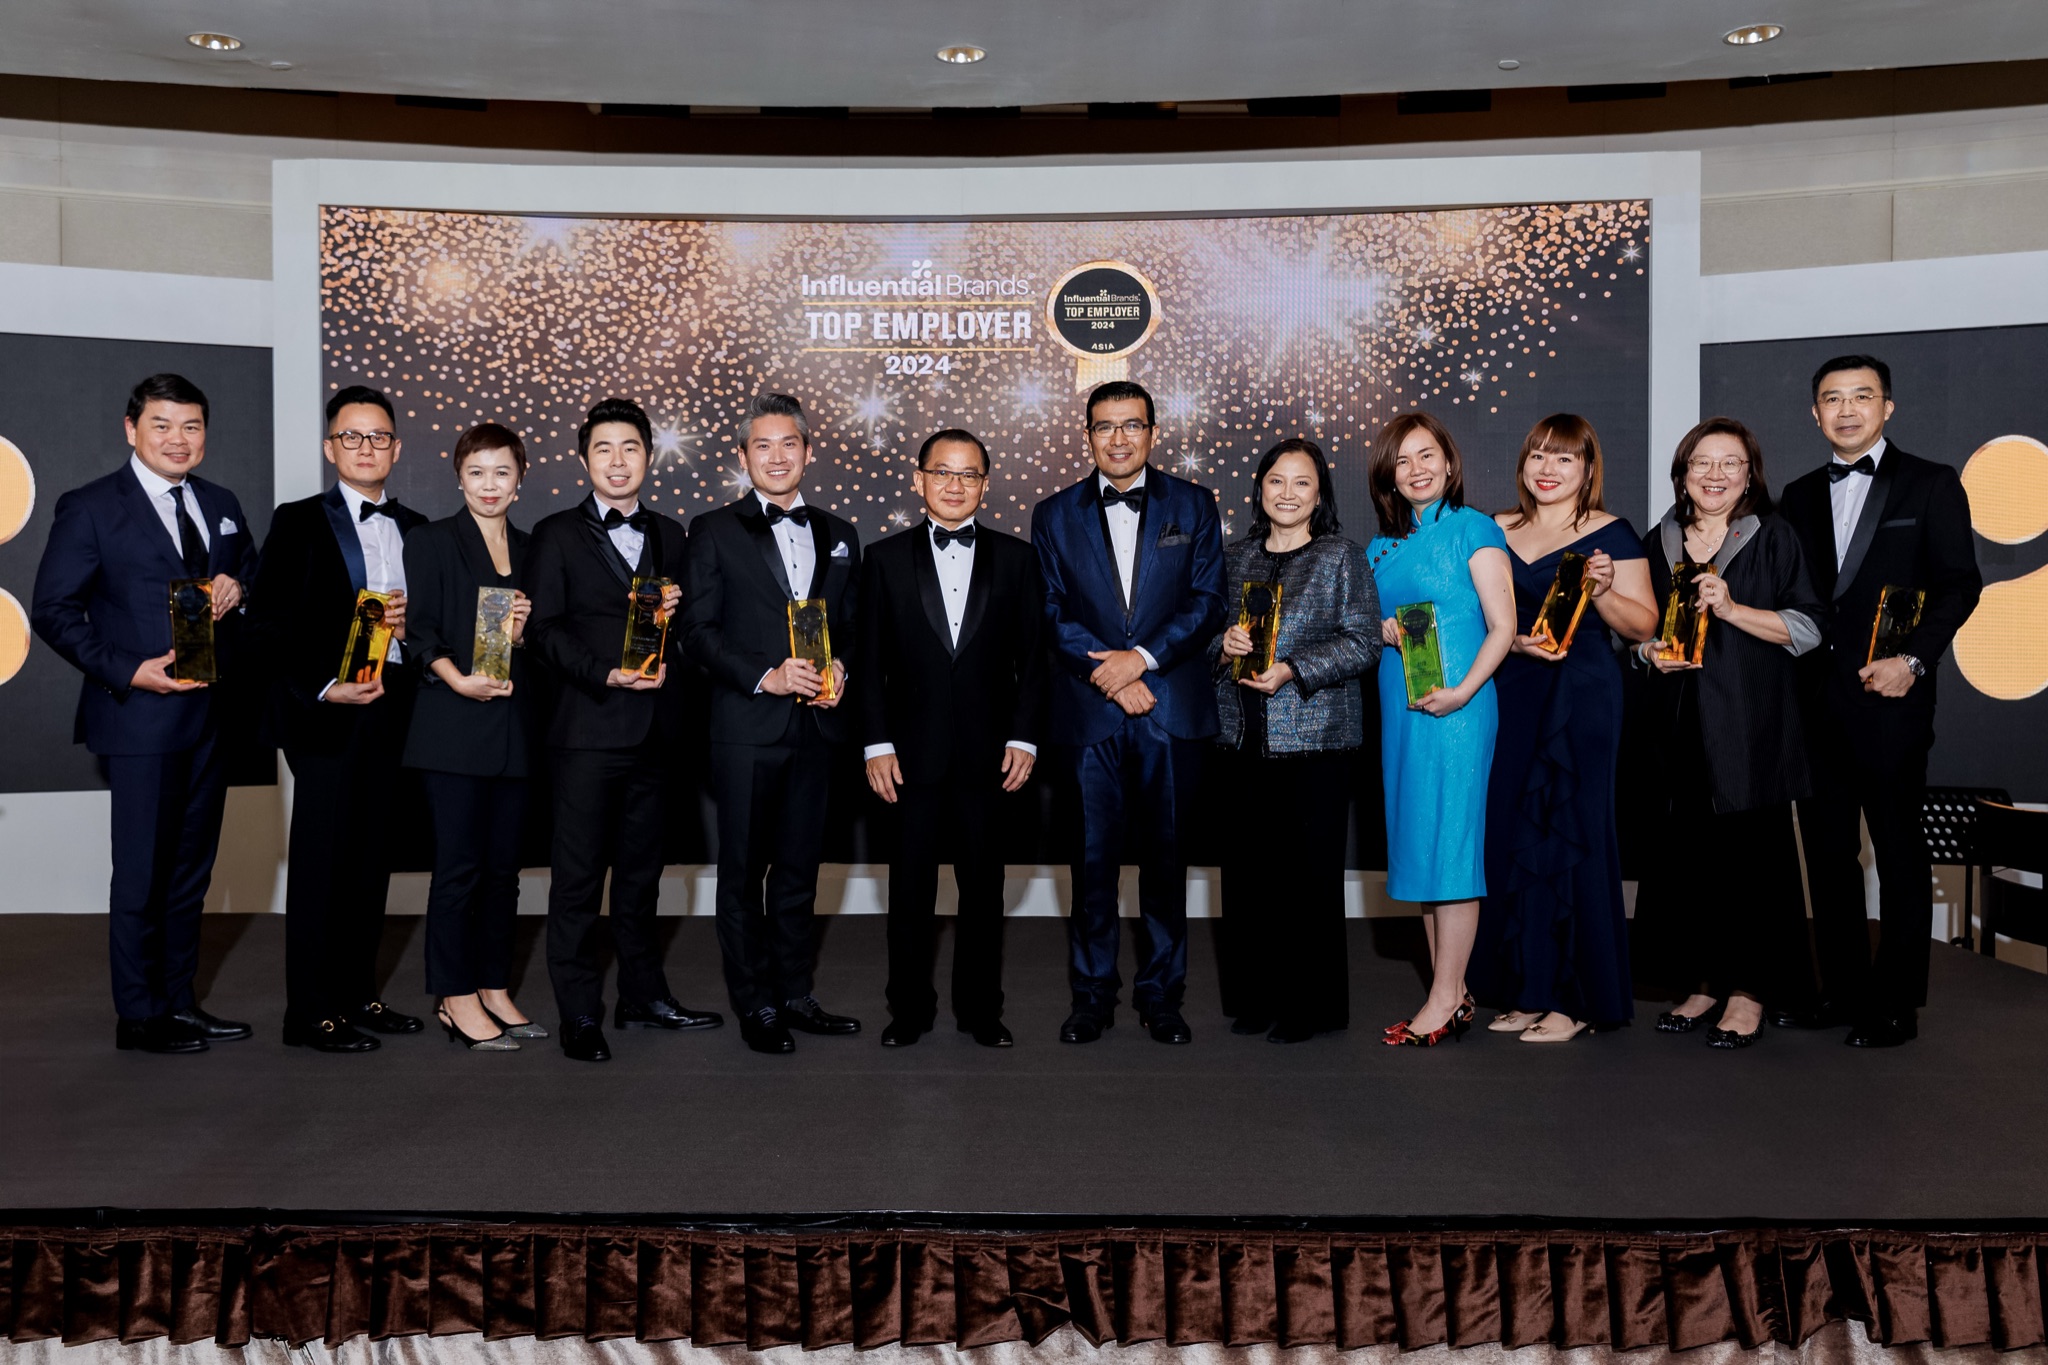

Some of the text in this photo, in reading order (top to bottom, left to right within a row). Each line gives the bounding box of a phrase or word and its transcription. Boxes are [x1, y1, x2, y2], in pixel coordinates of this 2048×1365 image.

[802, 274, 942, 296] Influential
[1064, 294, 1110, 302] Influential
[1065, 306, 1140, 317] TOP EMPLOYER
[805, 311, 1032, 340] TOP EMPLOYER
[1091, 321, 1115, 329] 2024
[1091, 342, 1115, 351] ASIA
[885, 355, 952, 375] 2024
